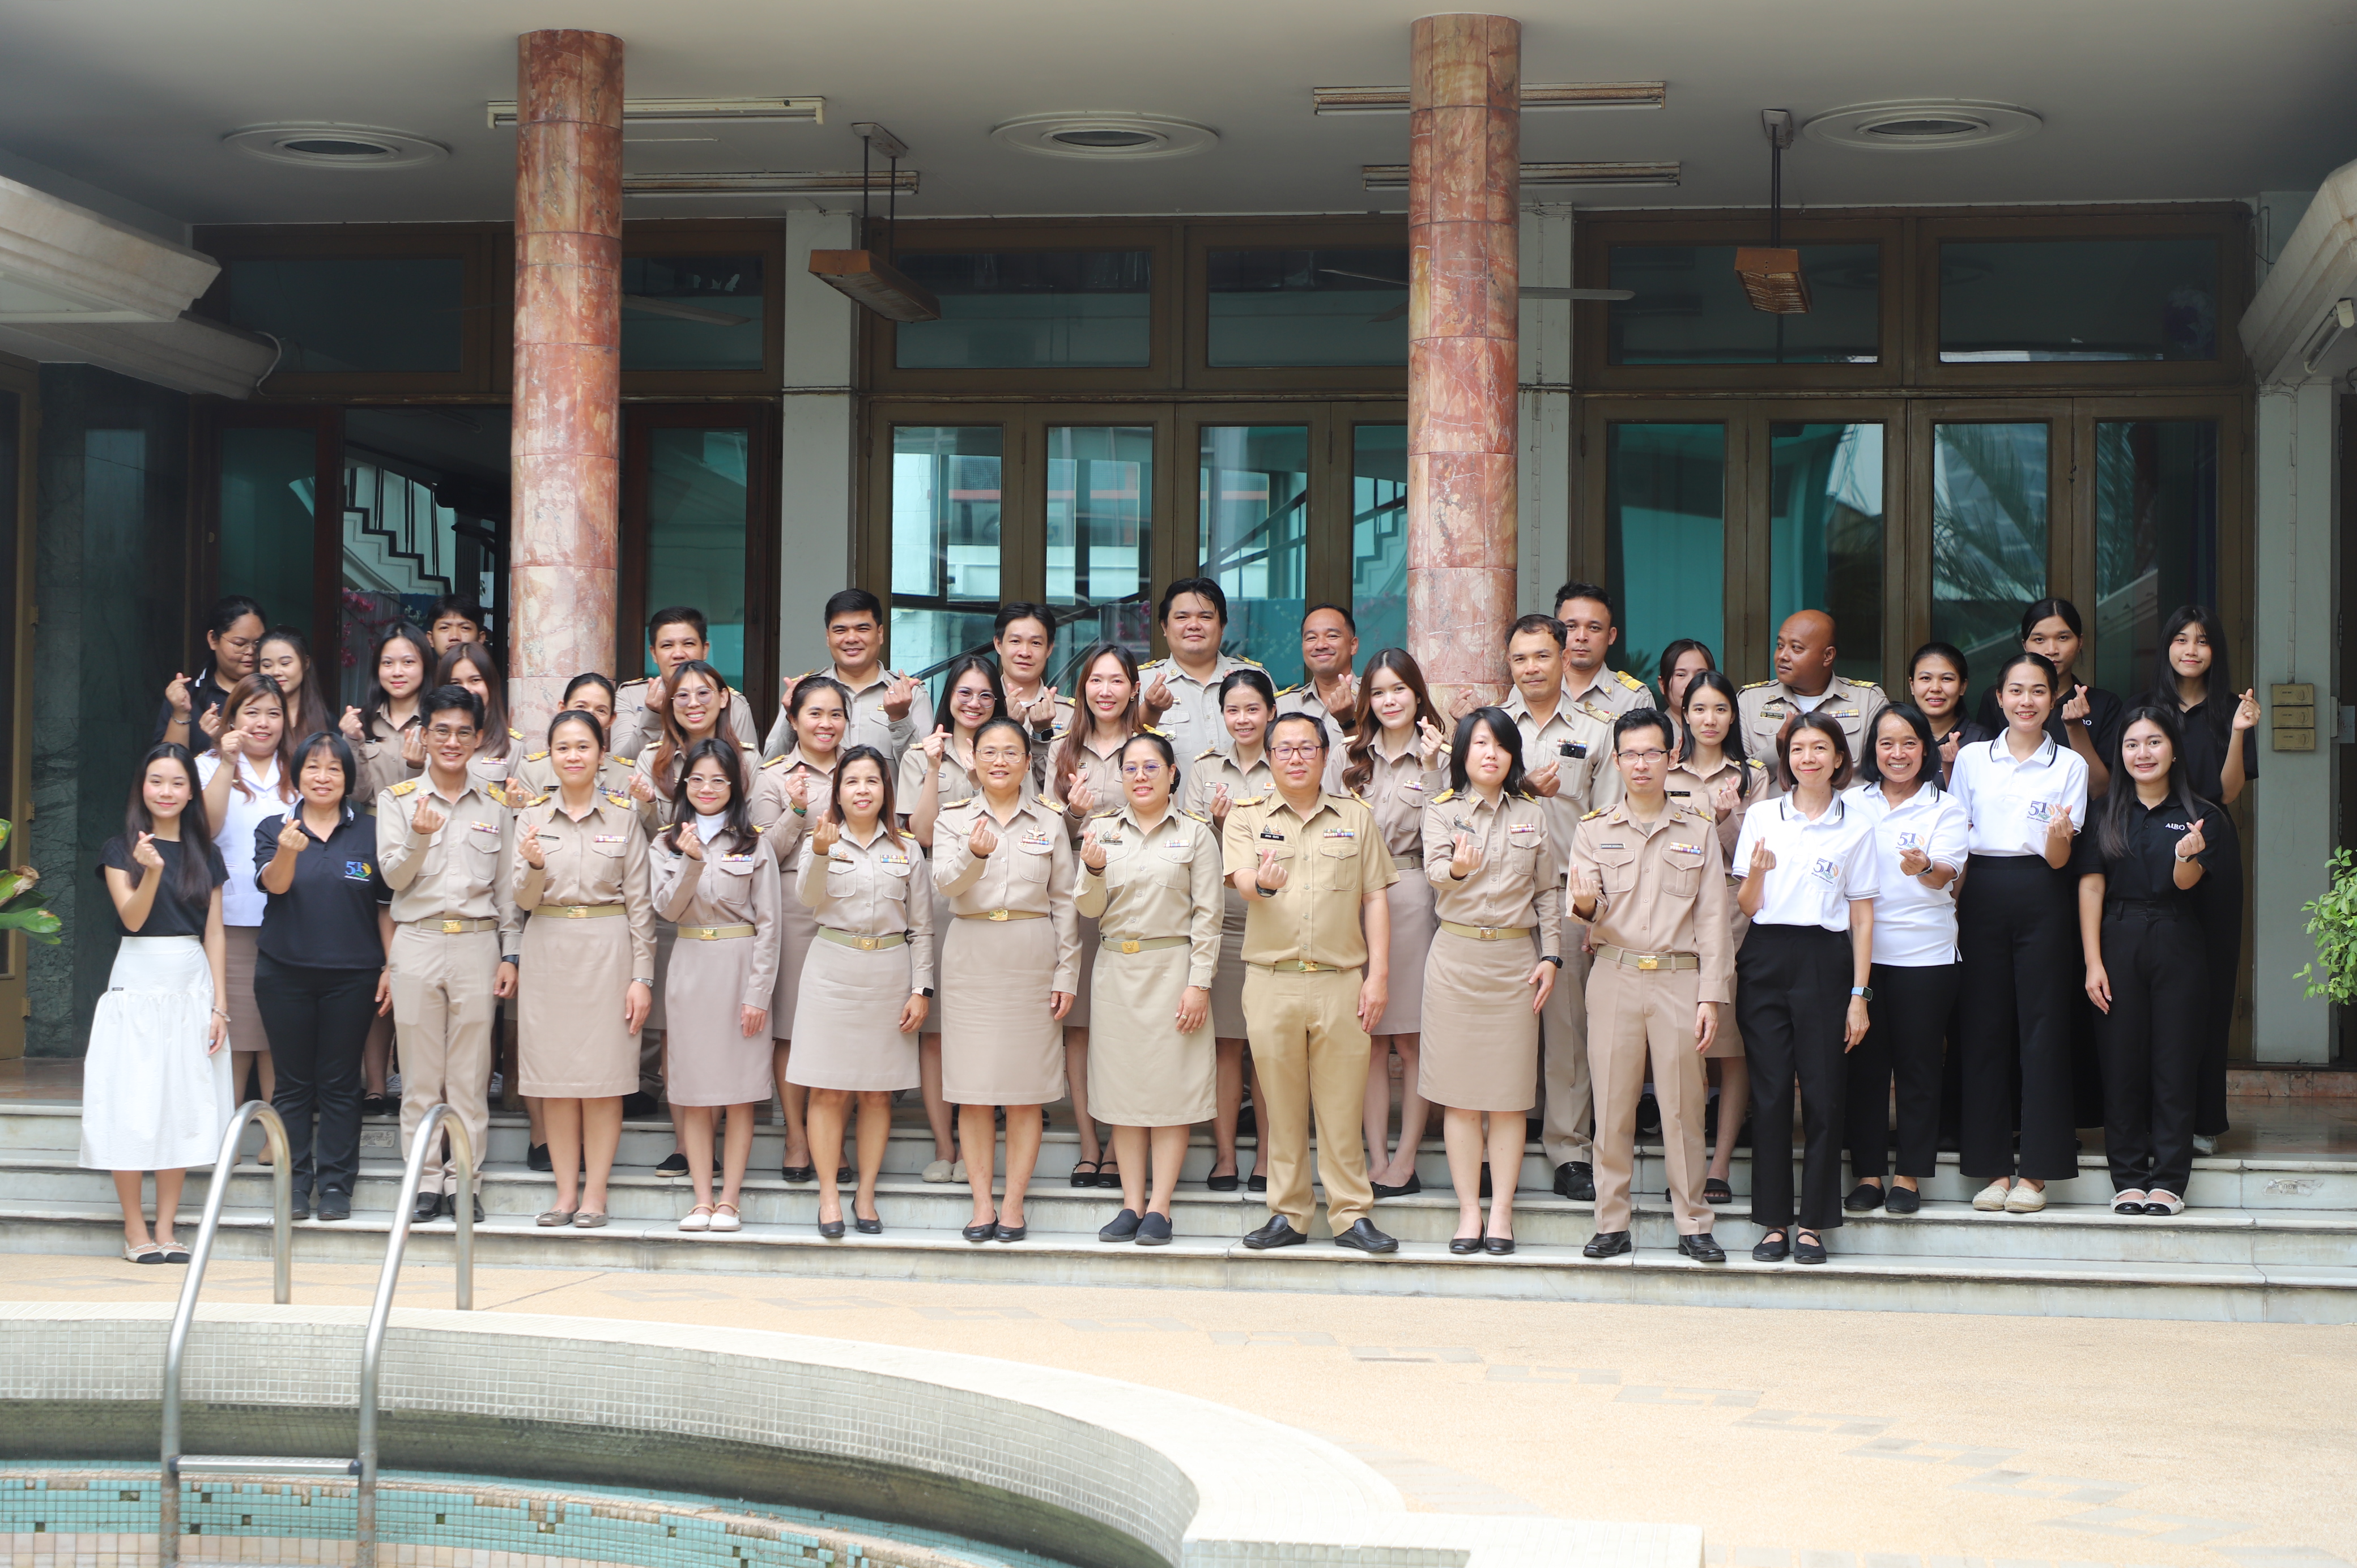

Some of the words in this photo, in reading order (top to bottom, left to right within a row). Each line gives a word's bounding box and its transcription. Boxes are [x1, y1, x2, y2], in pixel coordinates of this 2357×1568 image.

[2028, 800, 2047, 816] 51
[1897, 832, 1916, 846] 51
[344, 861, 363, 876] 51
[1814, 858, 1833, 873] 51
